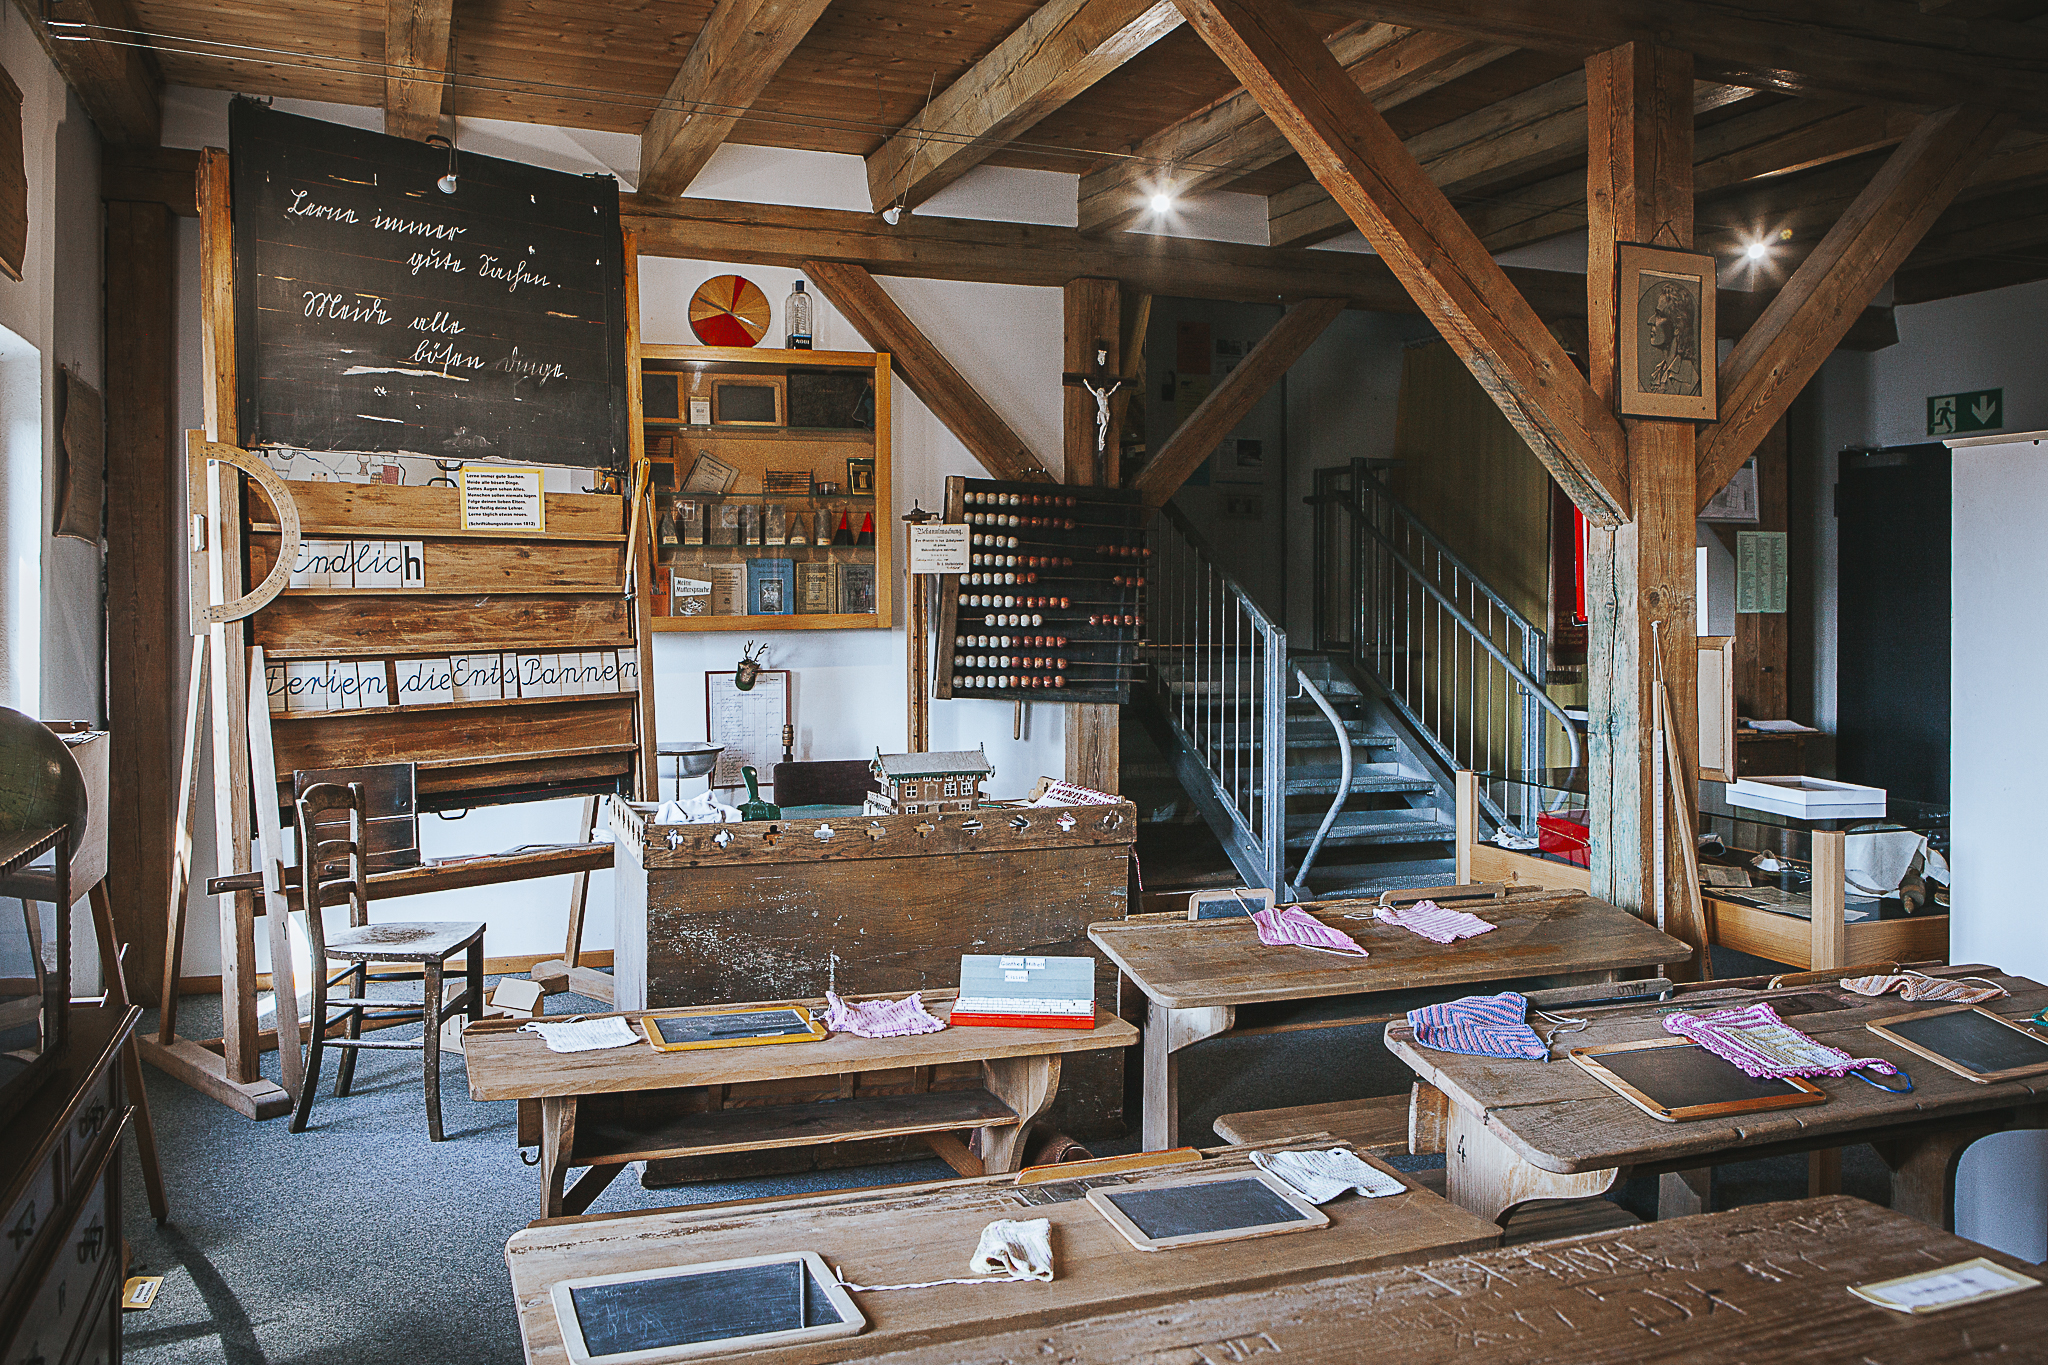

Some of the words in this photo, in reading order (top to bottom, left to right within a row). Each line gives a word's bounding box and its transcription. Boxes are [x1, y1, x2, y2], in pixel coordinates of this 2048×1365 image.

[287, 189, 359, 224] Lerne
[370, 208, 467, 241] immer
[302, 290, 393, 326] Meide
[407, 311, 466, 334] alle
